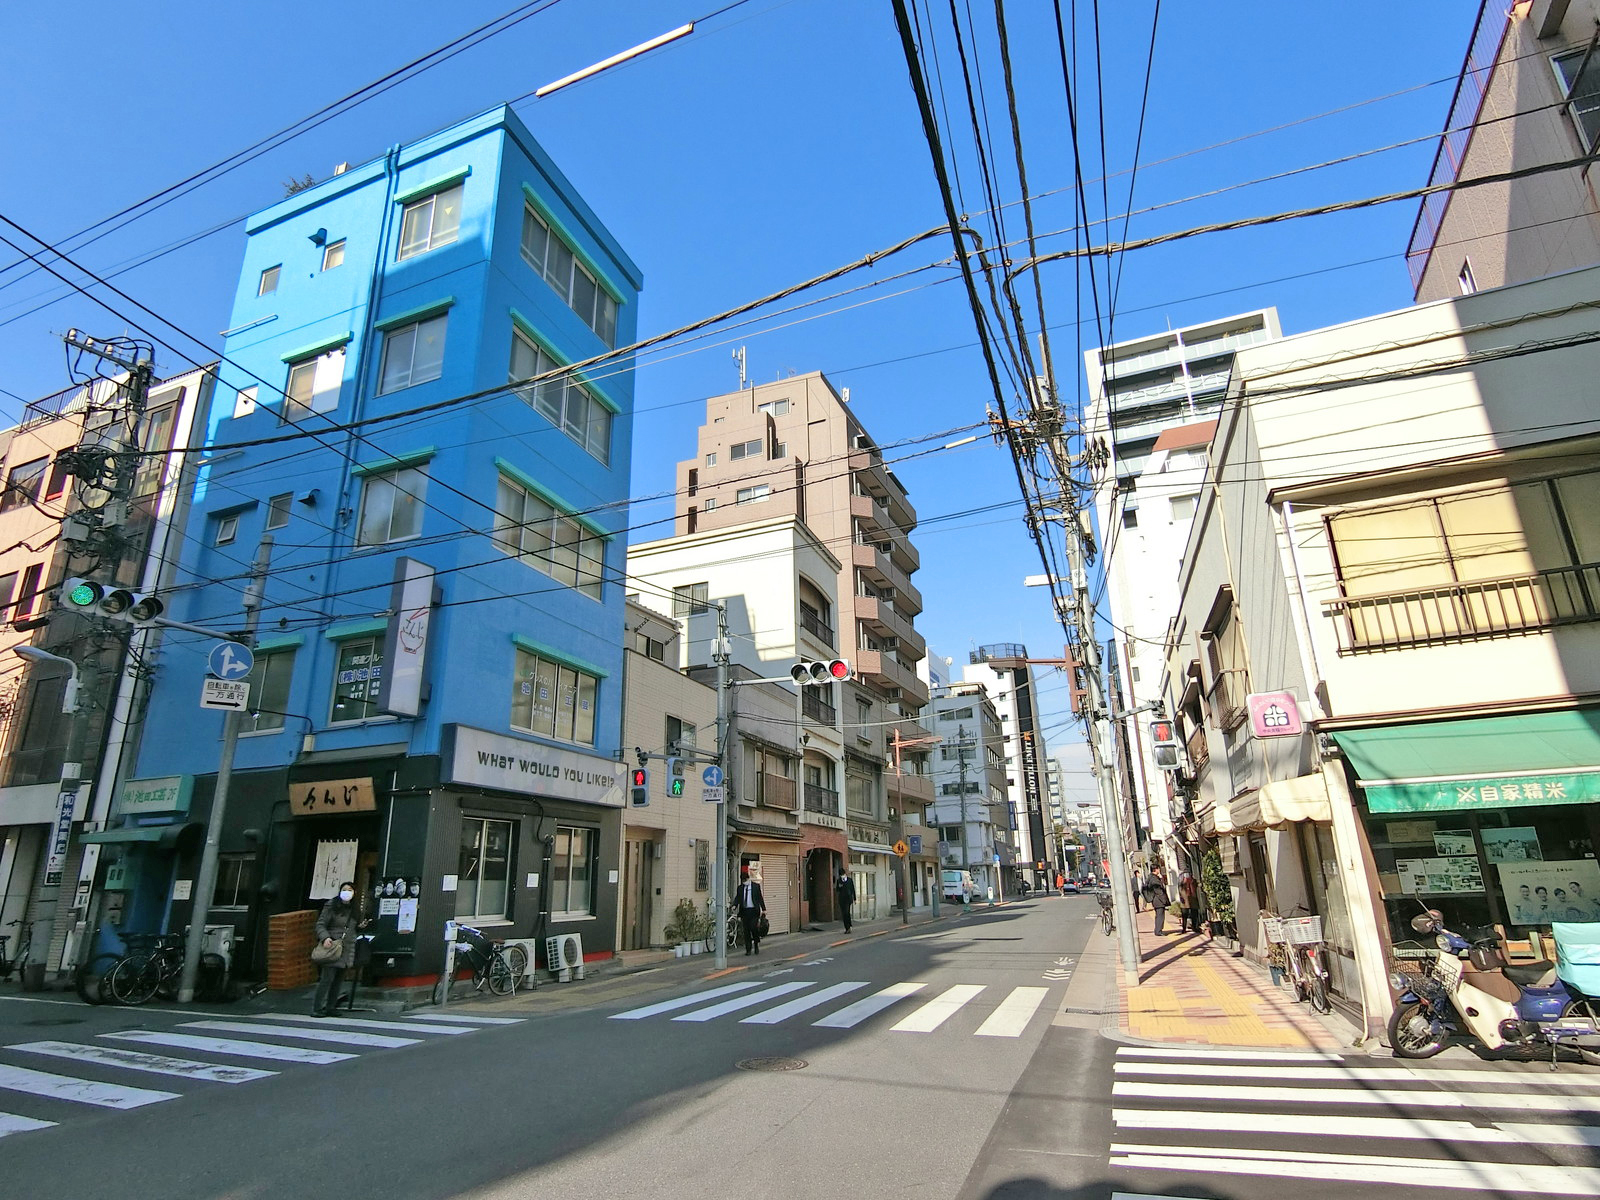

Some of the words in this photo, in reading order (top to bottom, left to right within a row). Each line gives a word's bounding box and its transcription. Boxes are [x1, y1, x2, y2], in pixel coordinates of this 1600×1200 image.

[206, 691, 245, 701] 一方通行
[519, 759, 560, 779] WOULD
[564, 767, 584, 783] YOU
[1028, 764, 1037, 794] HOTEL
